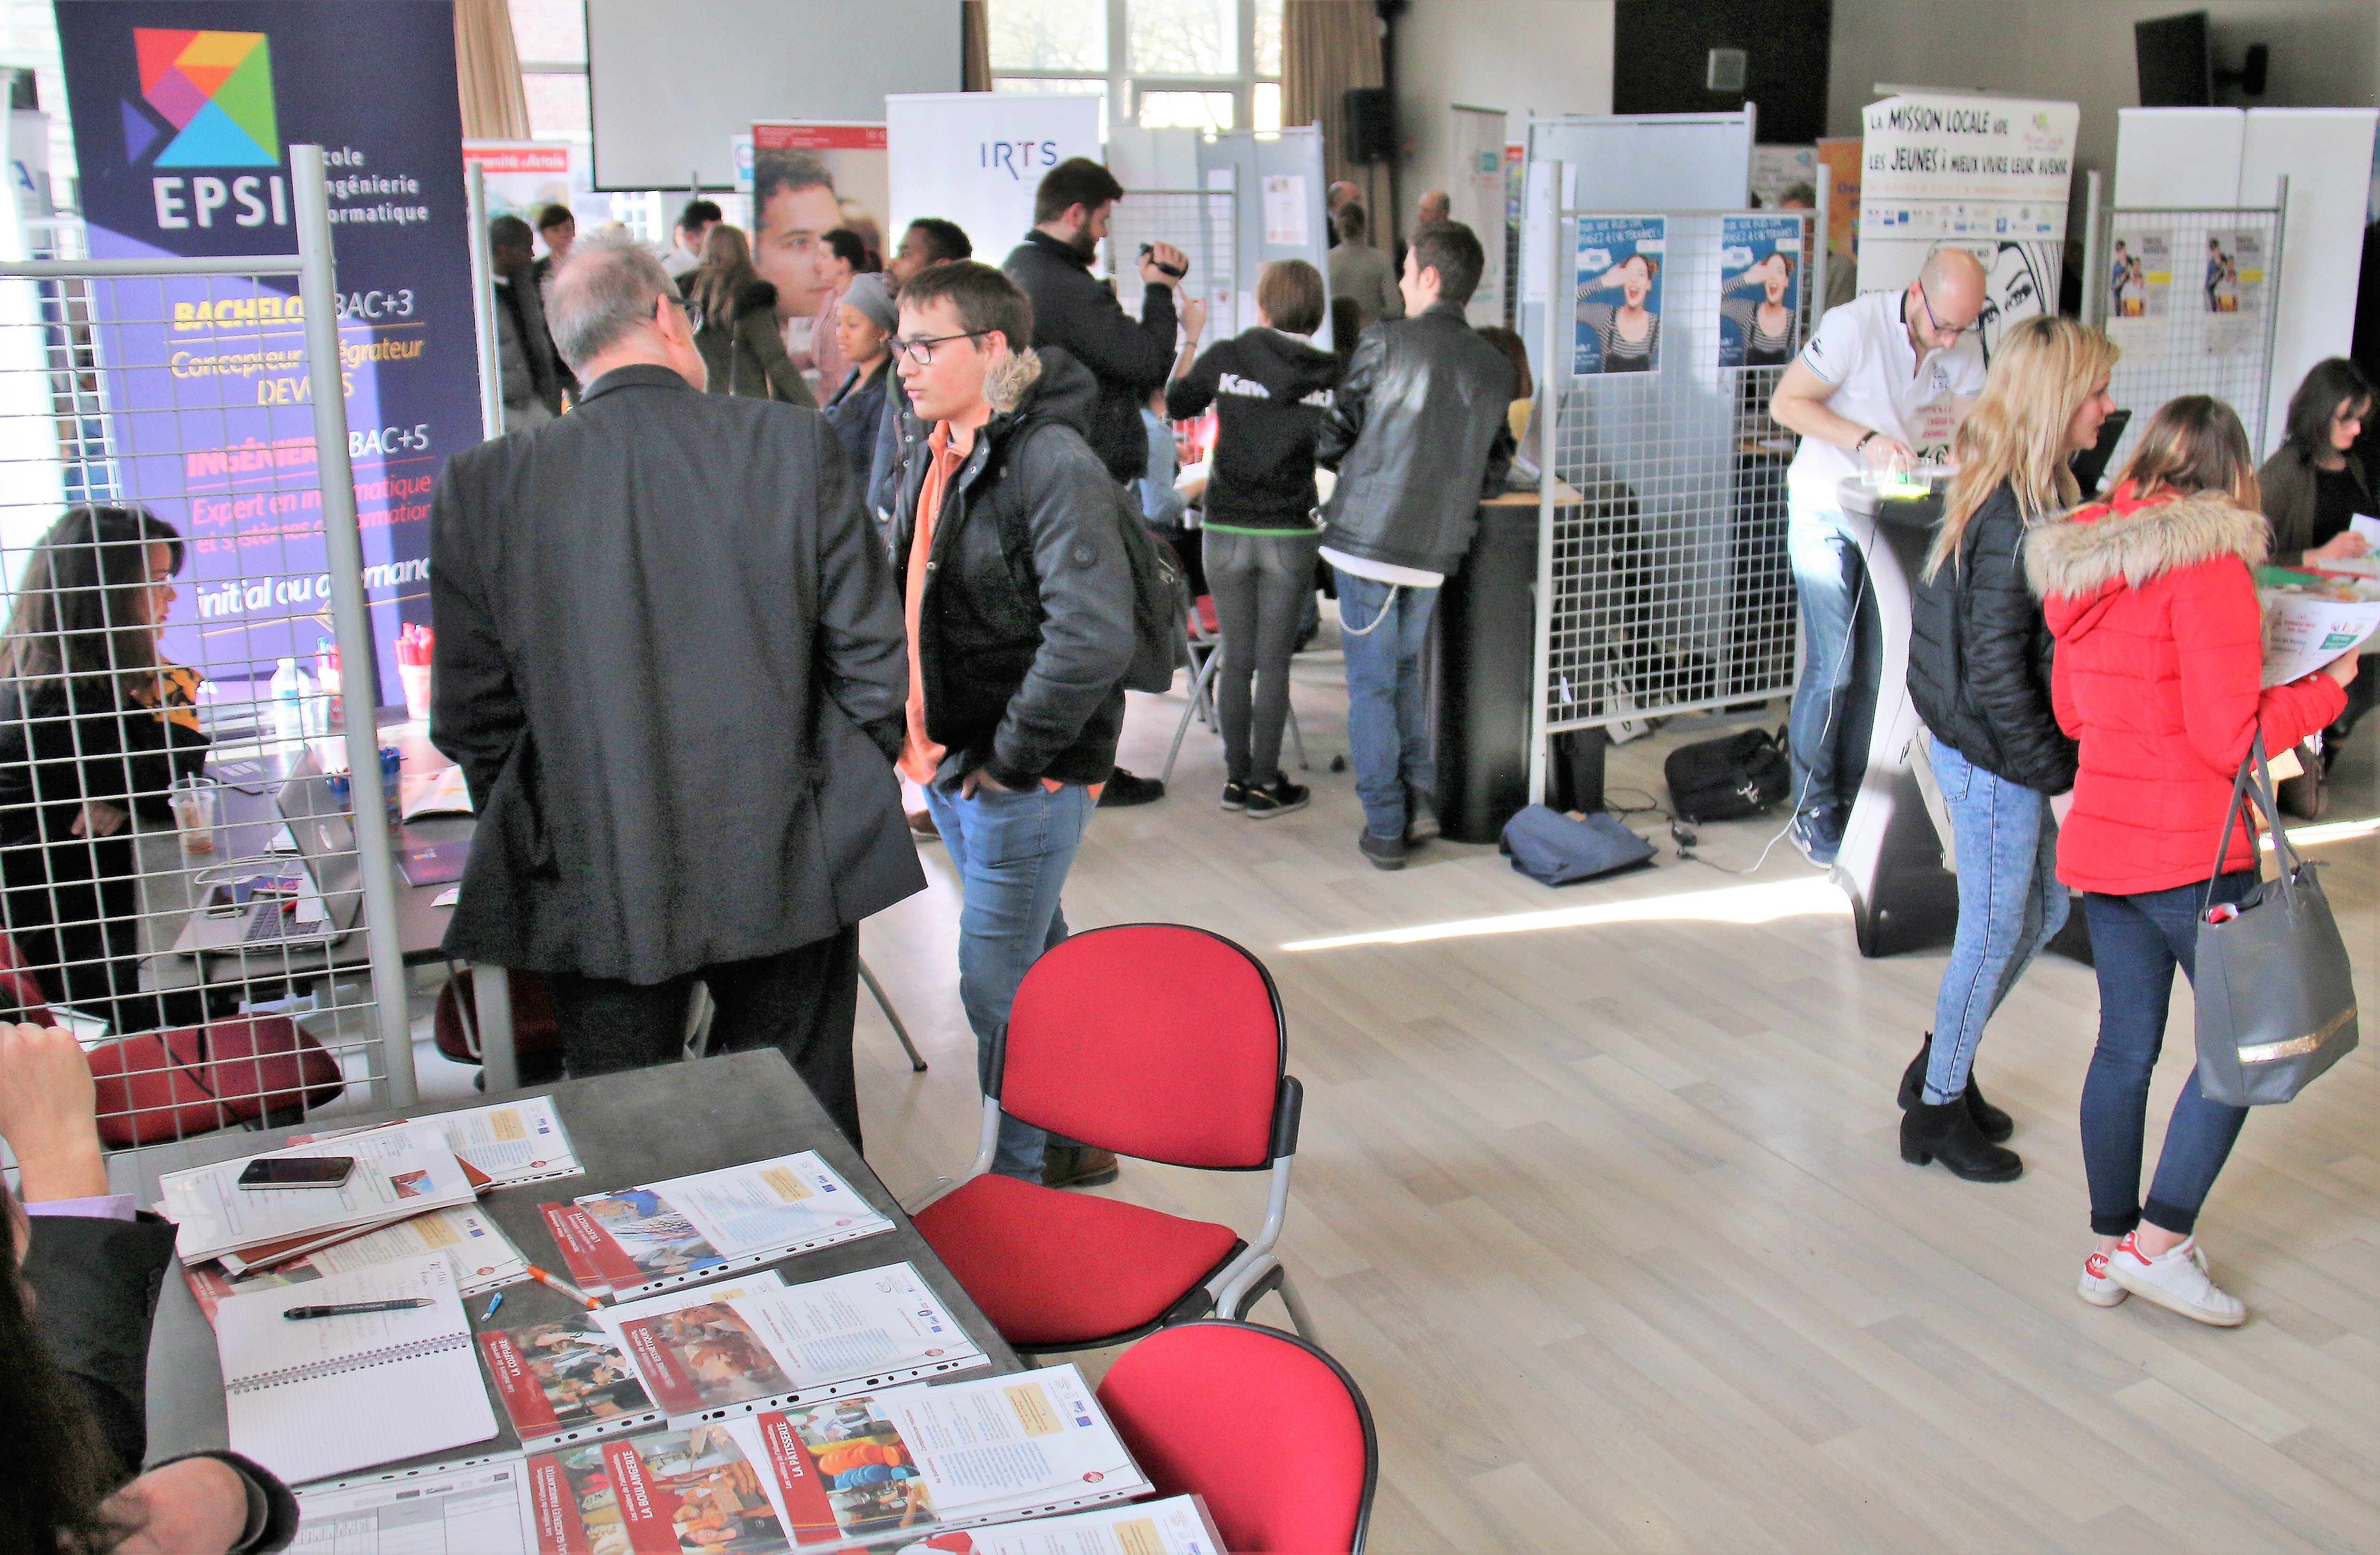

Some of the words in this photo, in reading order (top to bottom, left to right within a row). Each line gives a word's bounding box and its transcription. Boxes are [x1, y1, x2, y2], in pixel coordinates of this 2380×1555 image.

[1889, 106, 1943, 132] MISSION
[1946, 110, 1991, 133] LOCALE
[323, 145, 365, 166] cole
[980, 139, 1057, 180] IRTS
[1869, 154, 1885, 171] LES
[1890, 146, 1939, 172] JEUNES
[152, 175, 287, 229] EPSI
[324, 174, 420, 199] ngénierie
[327, 202, 430, 227] ormatique
[174, 295, 306, 331] BACHELO
[335, 288, 415, 320] BAC+3
[170, 349, 304, 378] Concepteur
[338, 336, 423, 369] égrateur
[257, 371, 355, 405] DEVS
[187, 436, 317, 477] INGÉNIER
[348, 423, 430, 459] BAC+5
[192, 492, 265, 528] Expert
[269, 492, 297, 515] en
[301, 474, 433, 510] inmatique
[196, 530, 218, 554] et
[196, 576, 273, 619] initial
[275, 577, 313, 605] ou
[314, 557, 431, 599] arnanc
[498, 1339, 517, 1368] COIFFURE
[639, 1327, 662, 1363] ESTHÉTIQUES
[511, 1367, 521, 1377] LA
[776, 1421, 800, 1466] PÂTISSERIE
[623, 1451, 650, 1507] BOULANGERIE
[791, 1466, 804, 1477] LA
[640, 1507, 654, 1519] LA
